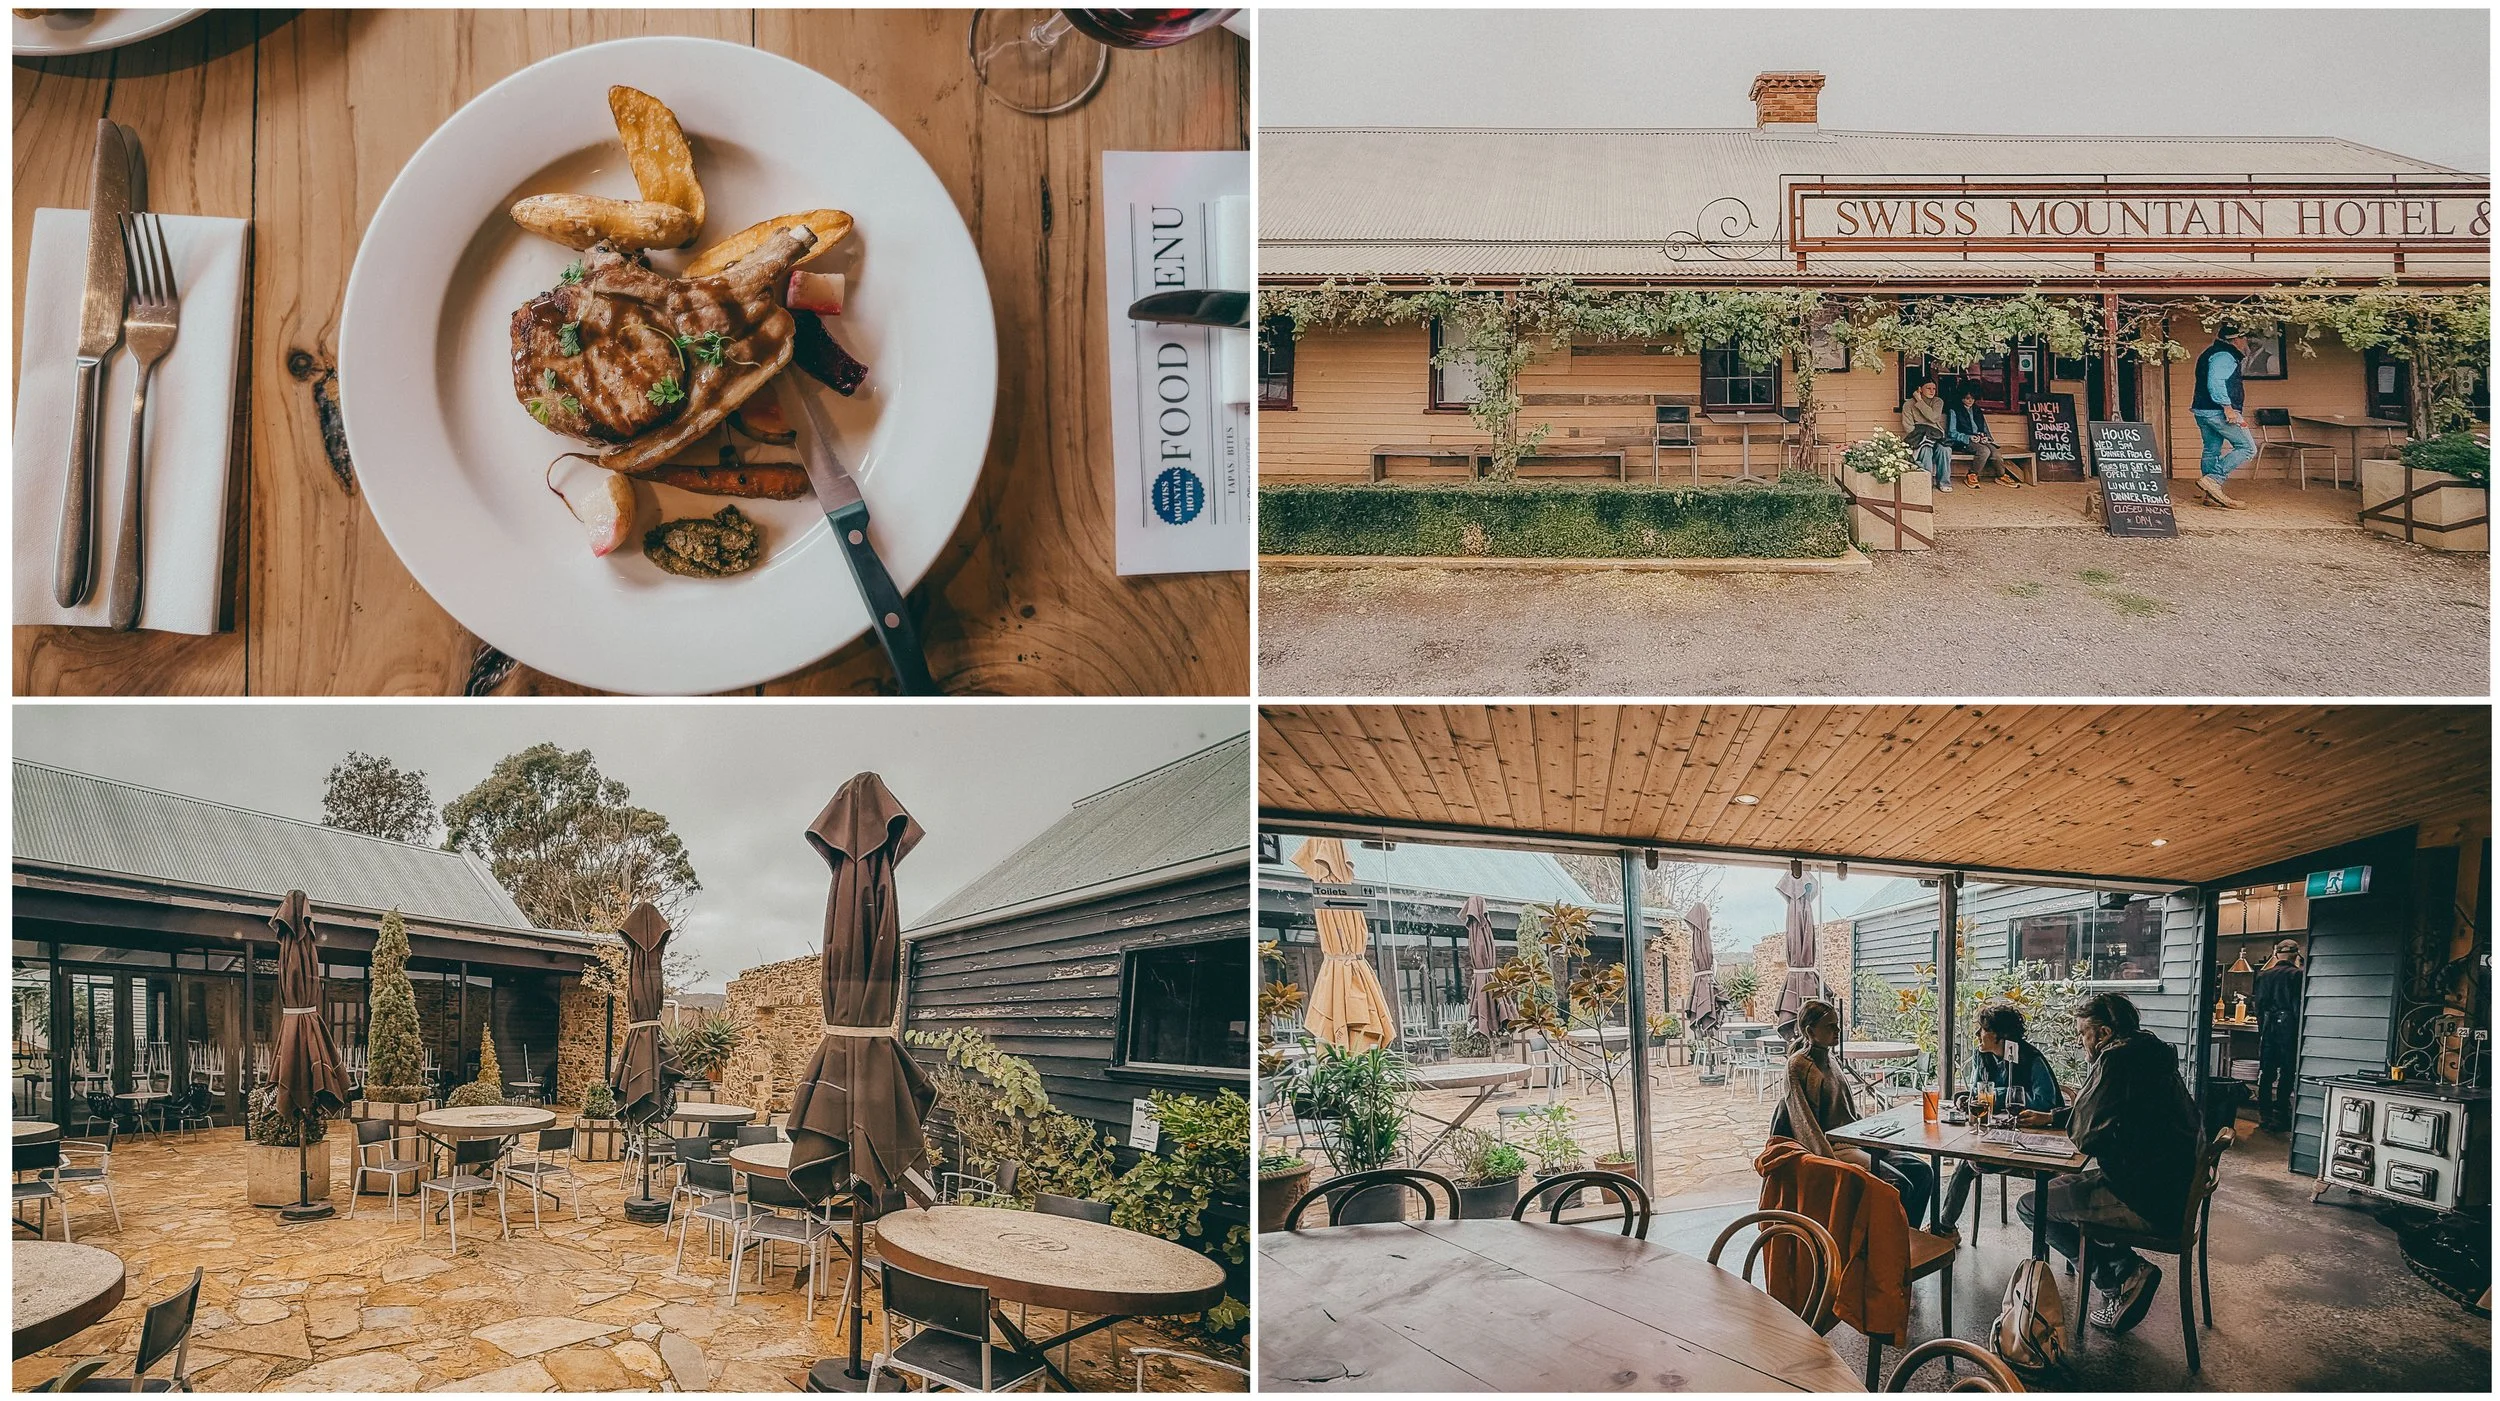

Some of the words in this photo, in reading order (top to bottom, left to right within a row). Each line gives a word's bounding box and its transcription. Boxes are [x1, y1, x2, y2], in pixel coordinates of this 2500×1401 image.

[1836, 200, 1978, 236] SWISS
[2006, 200, 2268, 236] MOUNTAIN
[2295, 200, 2456, 236] HOTEL
[2468, 200, 2491, 236] &
[1152, 204, 1186, 328] ENU
[1157, 342, 1191, 462] FOOD
[2028, 401, 2060, 414] LUNCH
[2036, 422, 2073, 433] DINNER
[1226, 427, 1235, 456] BITES
[2034, 430, 2059, 442] FROM
[2060, 432, 2070, 444] 6
[2101, 428, 2141, 442] HOURS
[2037, 442, 2056, 451] ALL
[2055, 443, 2071, 453] DAY
[2093, 440, 2113, 449] WED
[2039, 451, 2076, 461] SNACKS
[2100, 450, 2126, 459] DINNER
[2126, 450, 2144, 459] FROM
[2144, 449, 2153, 459] 6
[2130, 461, 2144, 471] SAT
[2147, 462, 2162, 471] SUN
[2105, 471, 2127, 479] OPEN
[2107, 480, 2136, 491] LUNCH
[2137, 480, 2159, 492] 12-3
[1161, 480, 1170, 512] SWISS
[1172, 469, 1183, 522] MOUNTAIN
[1185, 478, 1195, 512] HOTEL
[2109, 491, 2143, 503] DINNER
[2141, 493, 2164, 504] FROM
[2162, 493, 2171, 505] 6
[2112, 504, 2143, 514] CLOSED
[2134, 514, 2153, 527] DAY
[1314, 886, 1348, 896] Toilets
[2437, 1022, 2456, 1034] 18
